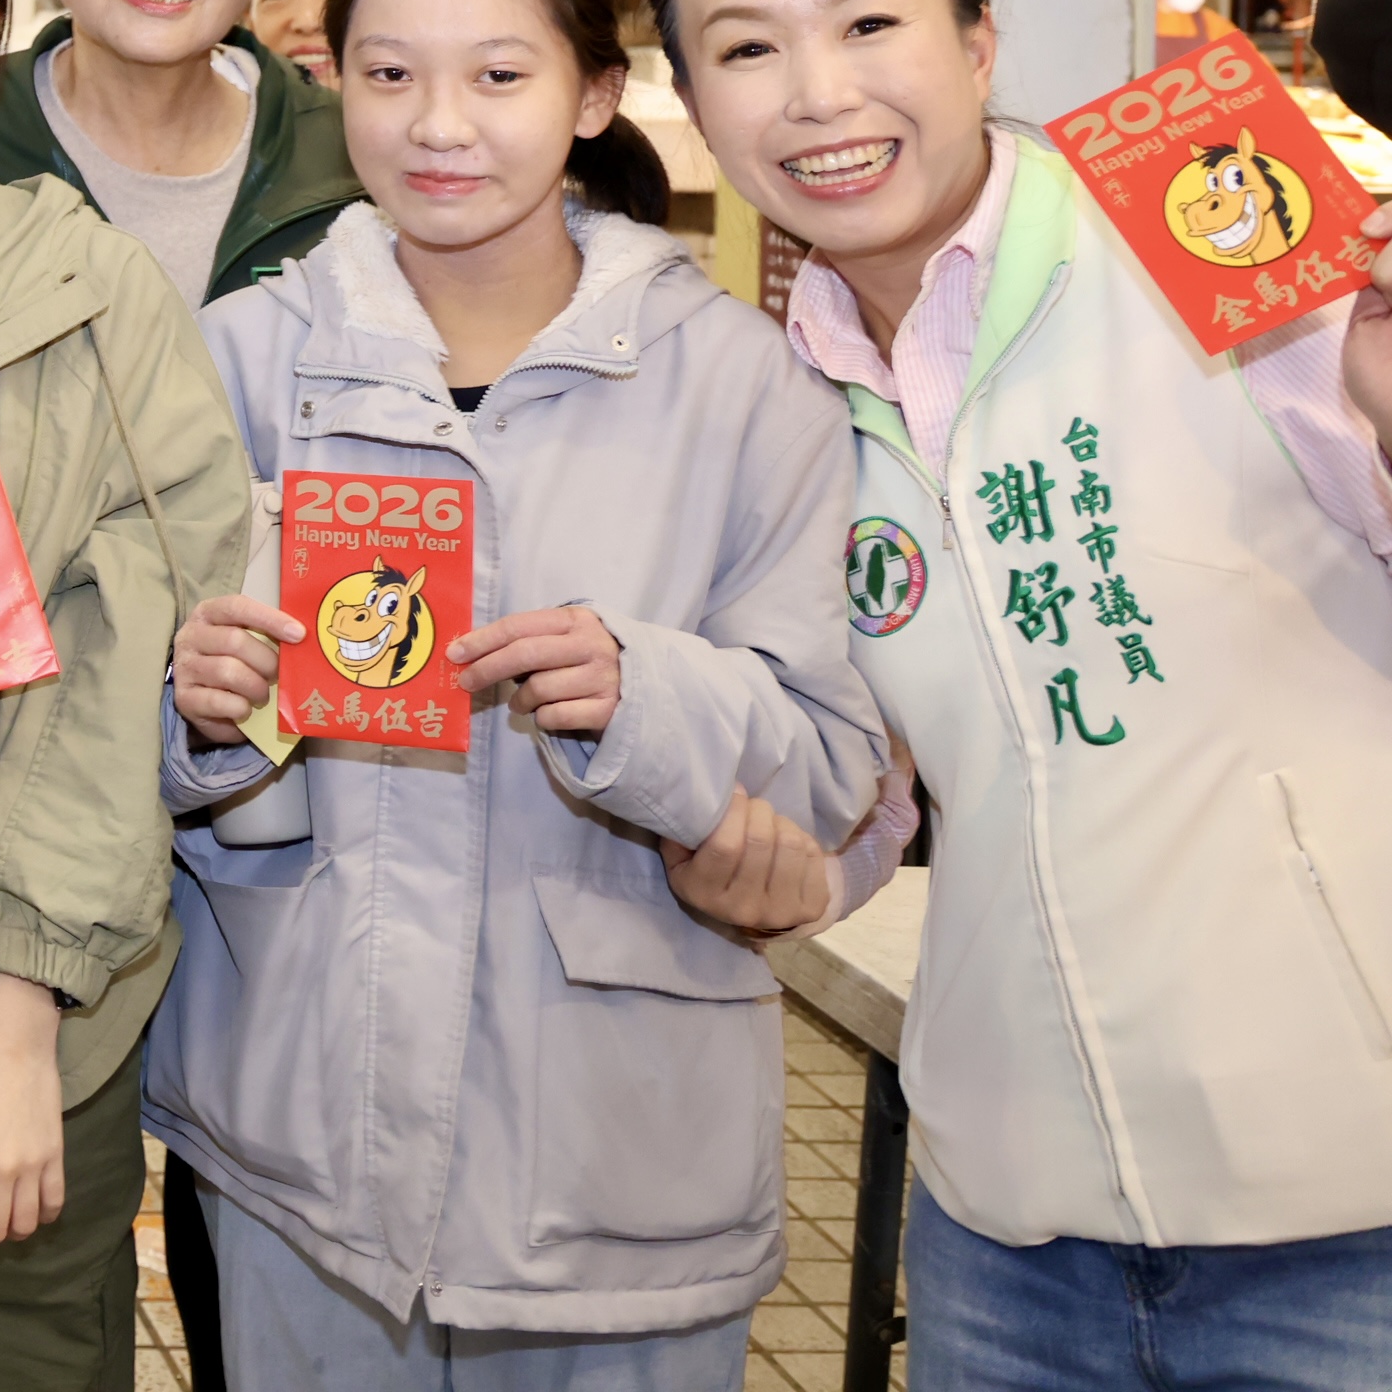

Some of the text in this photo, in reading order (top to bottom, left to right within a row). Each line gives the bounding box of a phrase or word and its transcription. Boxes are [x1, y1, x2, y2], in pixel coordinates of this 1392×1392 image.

[1062, 45, 1253, 163] 2026
[1088, 84, 1267, 179] Happy New Year
[1210, 234, 1374, 333] 金馬伍吉
[295, 479, 463, 532] 2026
[295, 524, 461, 553] Happy New Year
[1062, 416, 1165, 685] 台南市議員
[293, 546, 309, 578] 丙午
[976, 459, 1126, 746] 謝舒凡
[297, 688, 448, 738] 金馬伍吉
